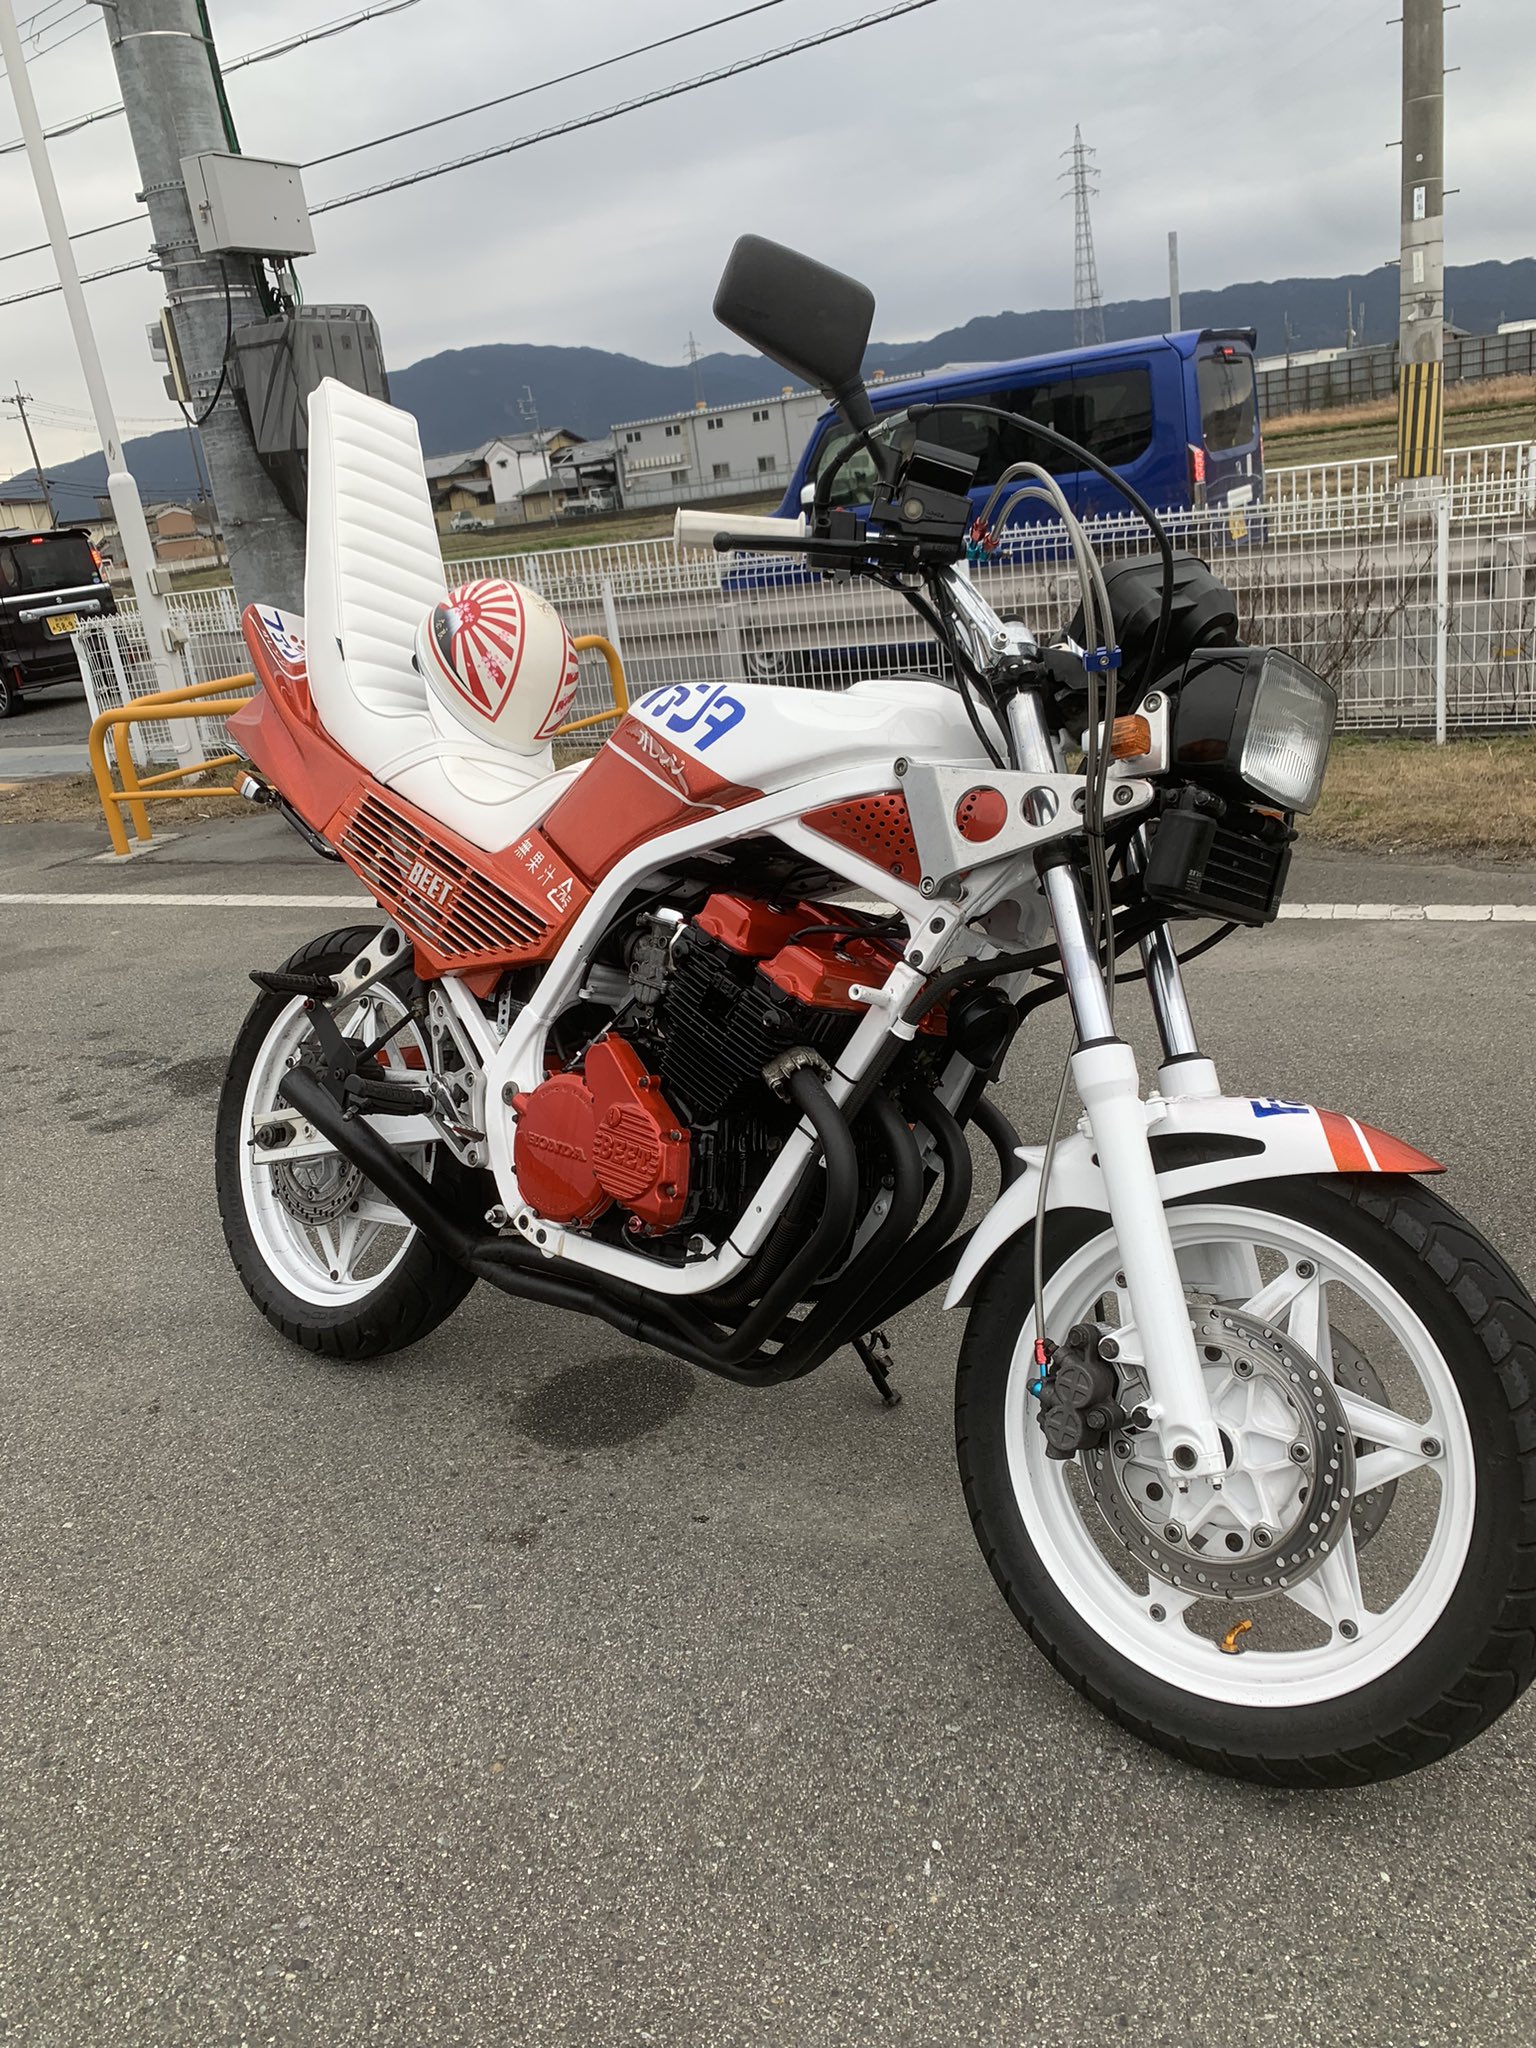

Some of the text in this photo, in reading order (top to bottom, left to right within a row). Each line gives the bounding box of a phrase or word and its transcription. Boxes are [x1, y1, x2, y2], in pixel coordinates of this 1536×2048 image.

[408, 861, 453, 906] BEET
[514, 838, 556, 886] 無果汁
[527, 1131, 587, 1163] HONDA
[600, 1134, 653, 1176] BEET
